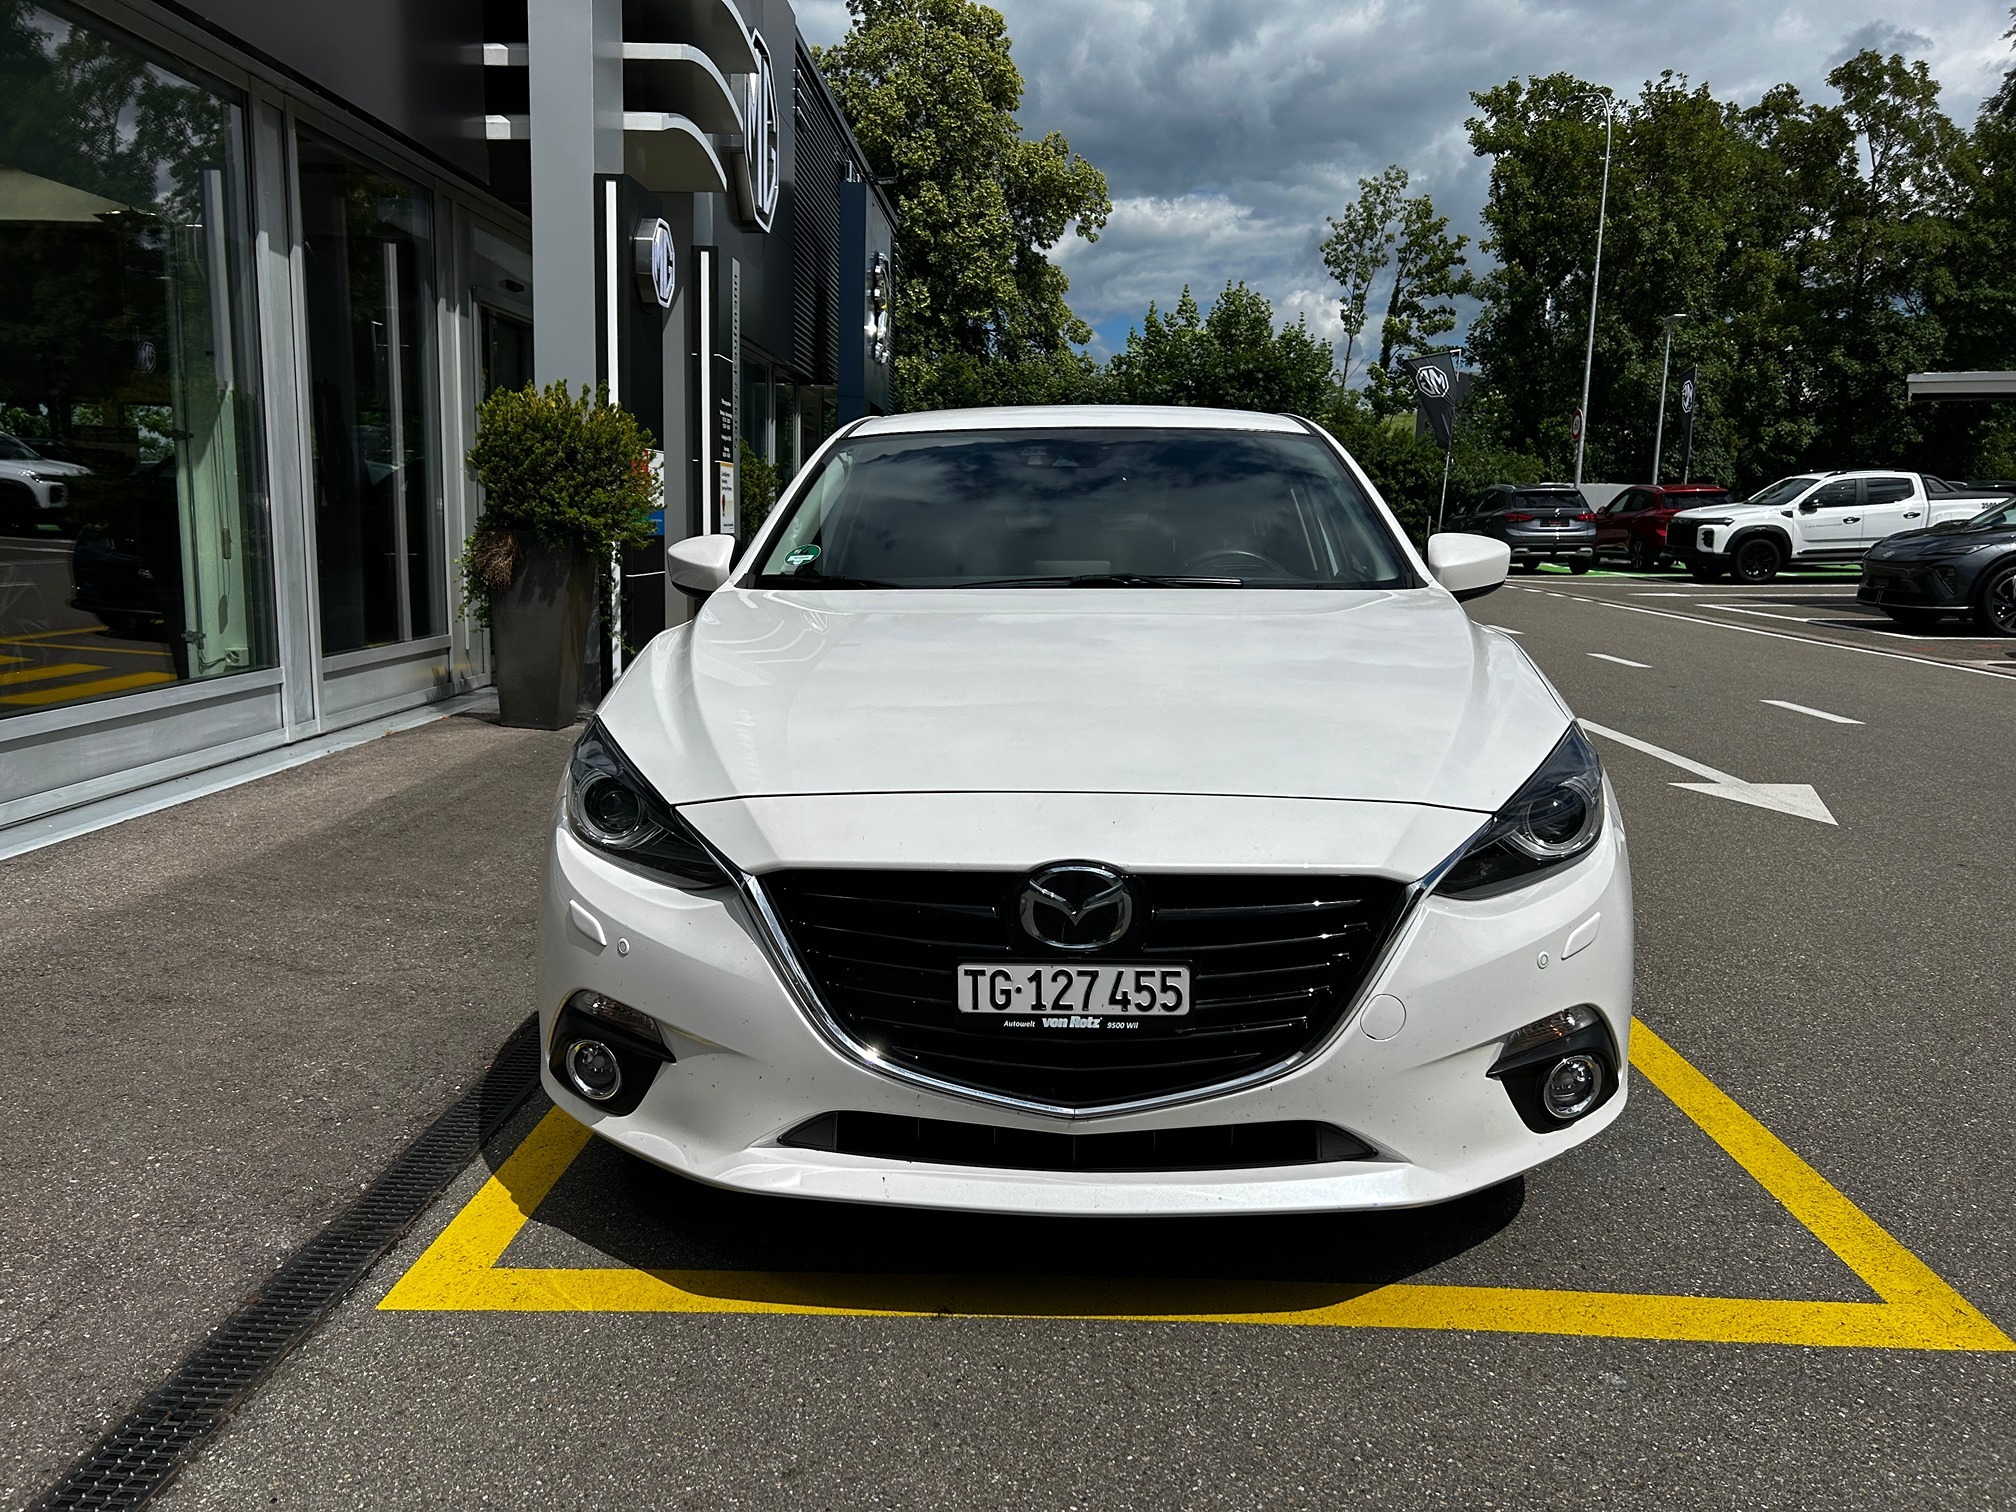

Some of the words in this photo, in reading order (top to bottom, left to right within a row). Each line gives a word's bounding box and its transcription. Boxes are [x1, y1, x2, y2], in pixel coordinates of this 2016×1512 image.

[654, 226, 674, 300] MG
[1003, 1020, 1036, 1028] Autowelt
[1041, 1017, 1069, 1028] von
[1069, 1015, 1101, 1029] Rotz
[1106, 1021, 1125, 1029] 9500
